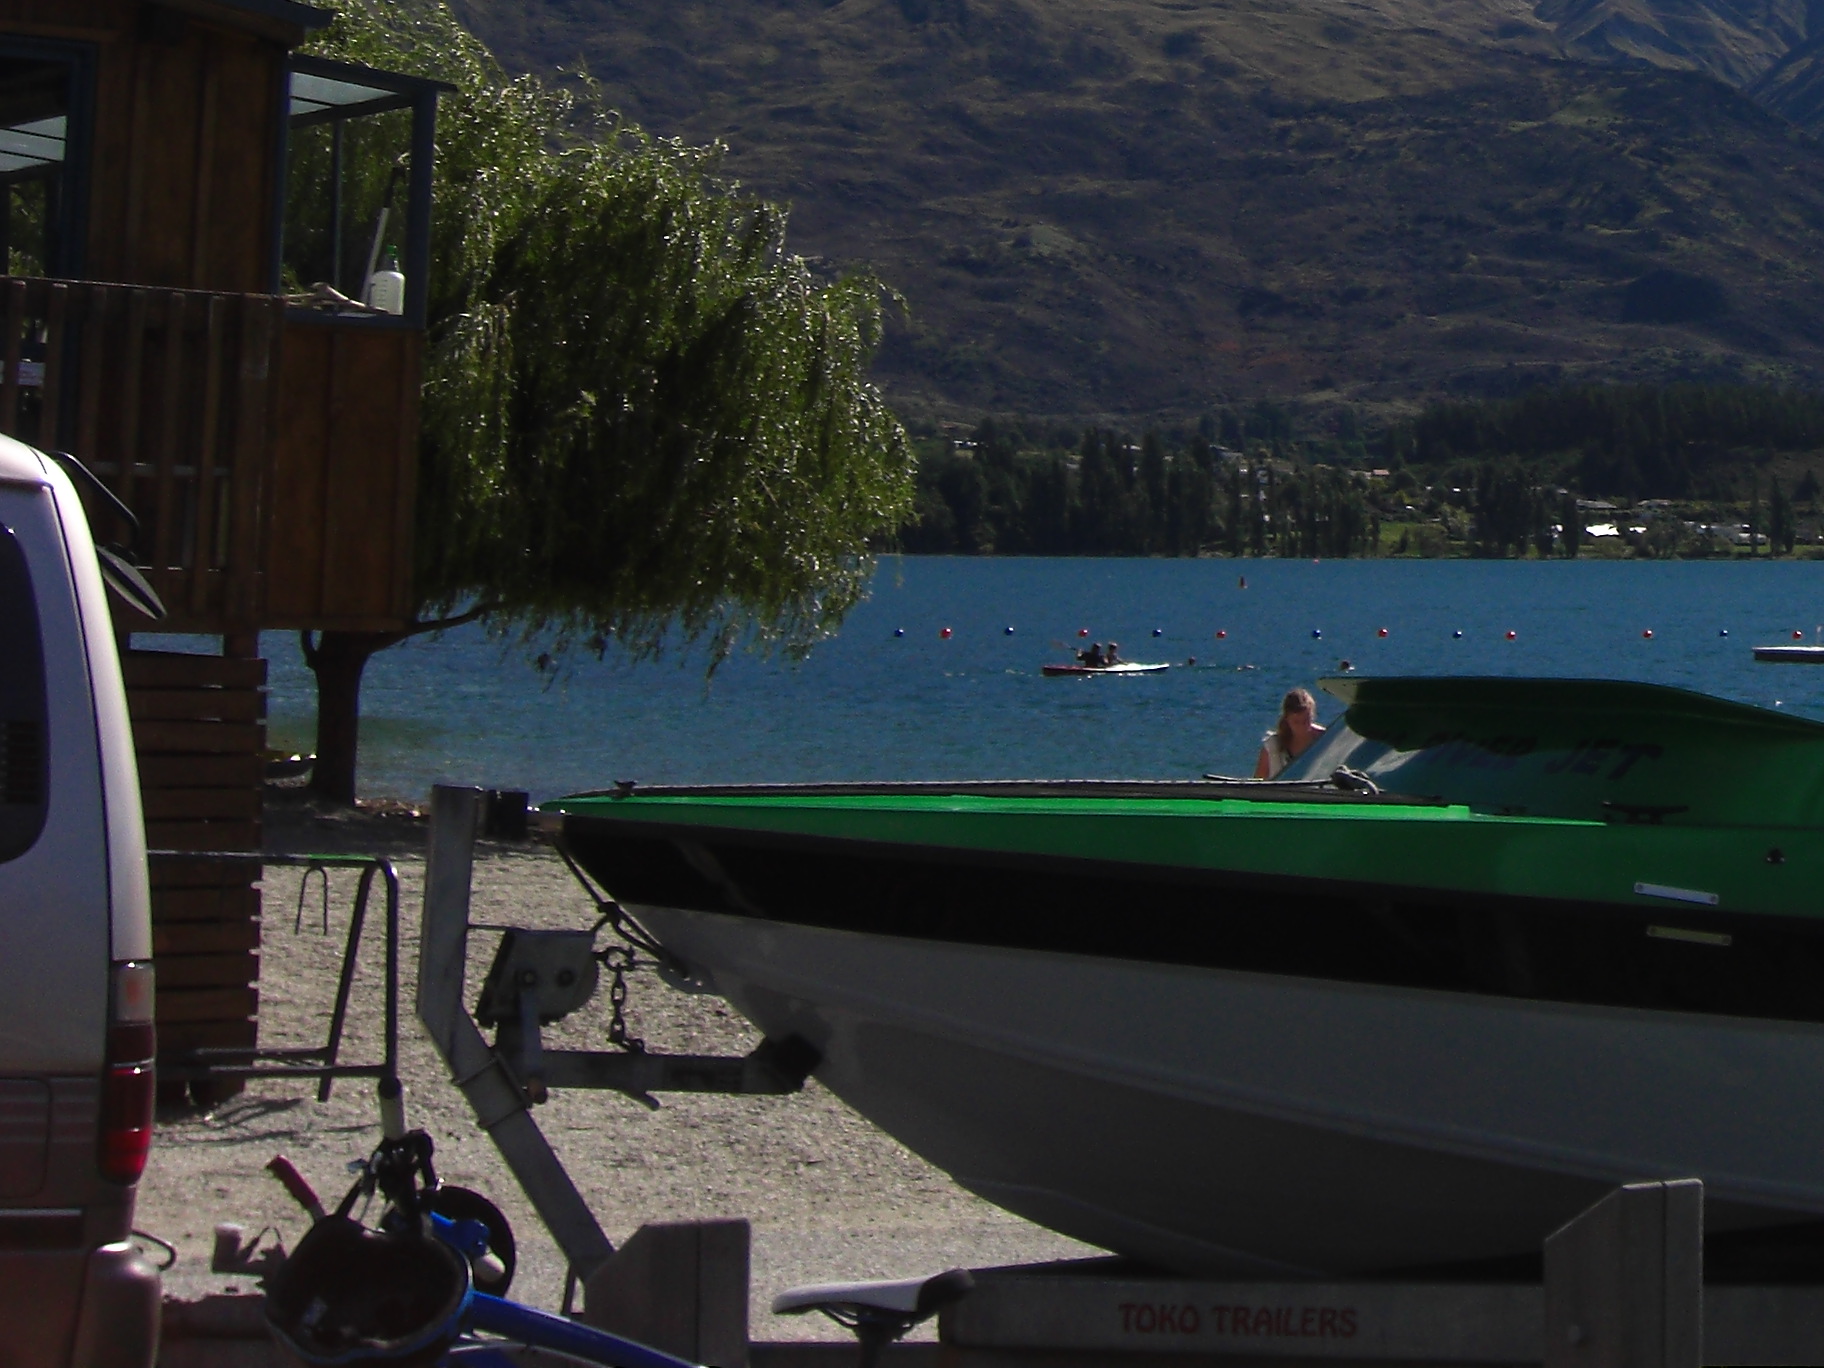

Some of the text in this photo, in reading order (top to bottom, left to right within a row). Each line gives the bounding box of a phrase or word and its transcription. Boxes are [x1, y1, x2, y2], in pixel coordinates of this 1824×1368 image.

[1543, 738, 1664, 781] JET
[1119, 1303, 1358, 1338] TOKO TRAILERS
